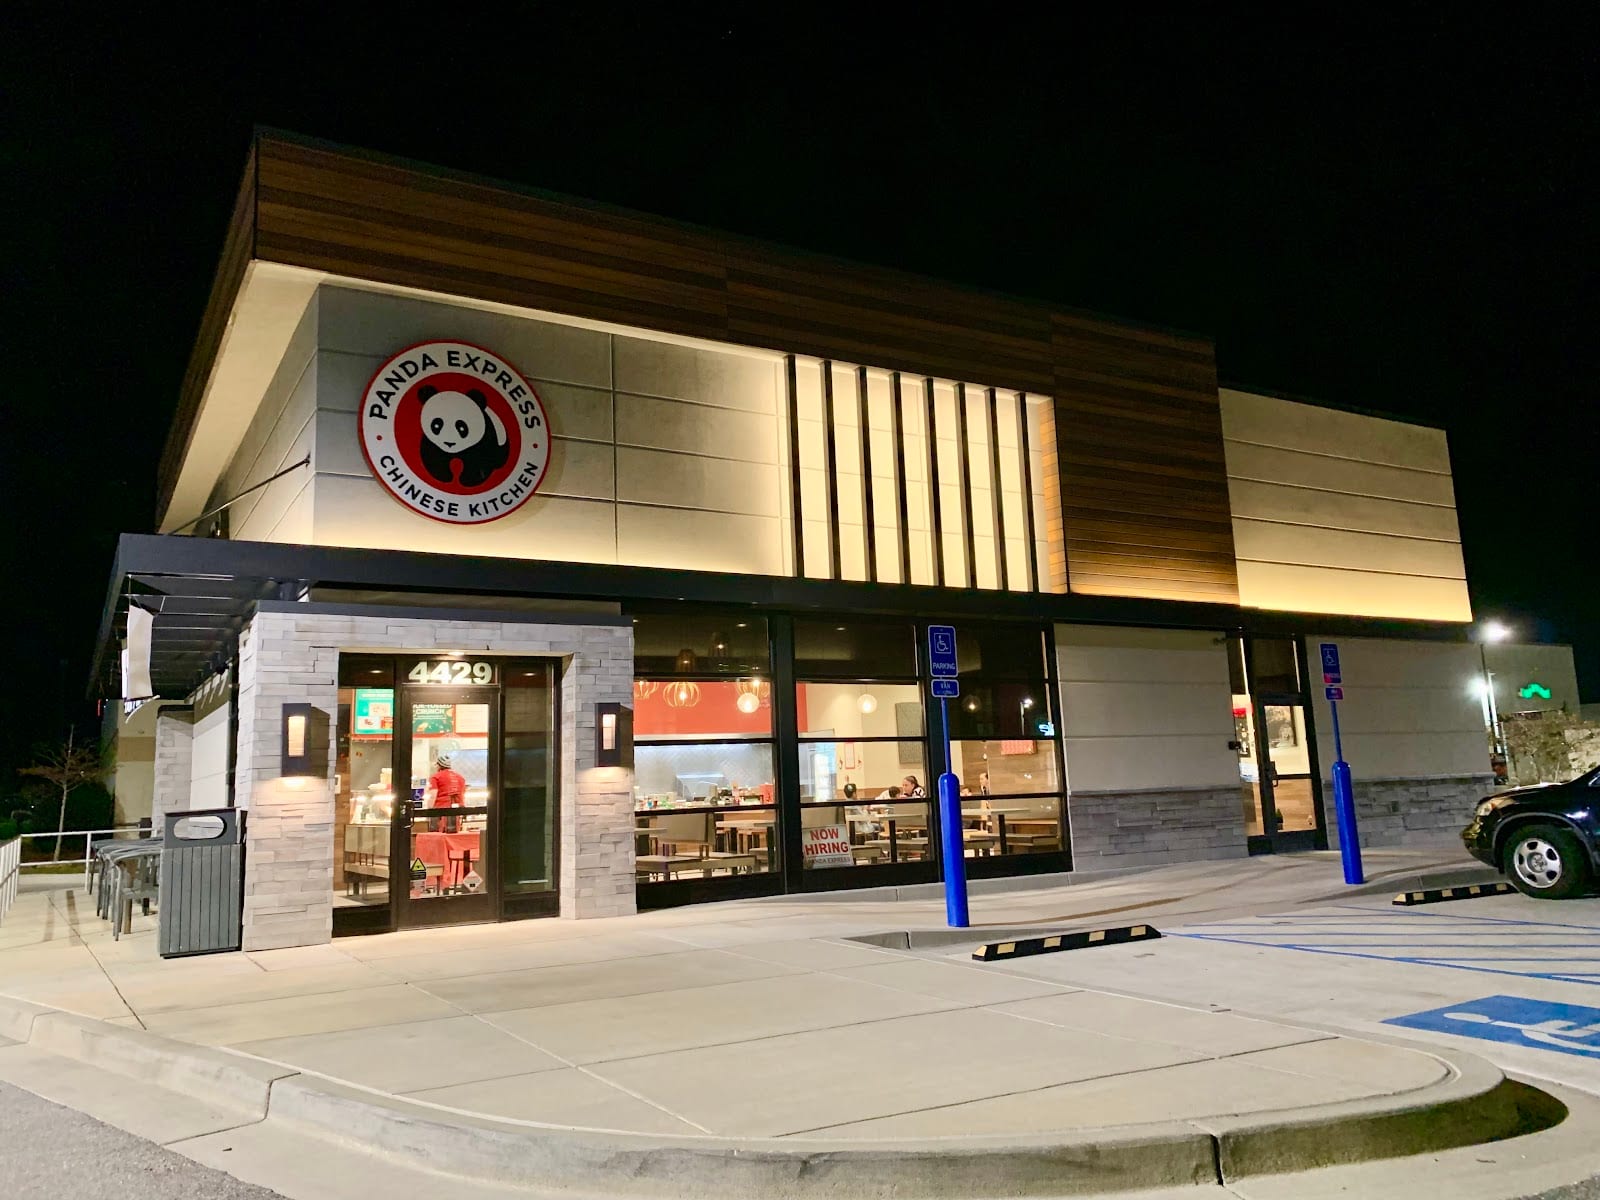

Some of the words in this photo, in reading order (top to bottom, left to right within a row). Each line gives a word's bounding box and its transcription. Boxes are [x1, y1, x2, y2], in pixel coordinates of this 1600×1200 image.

[369, 353, 439, 420] PANDA
[447, 350, 541, 429] EXPRESS
[380, 455, 459, 516] CHINESE
[469, 462, 539, 517] KITCHEN
[408, 661, 492, 685] 4429
[932, 662, 956, 670] PARKING
[809, 828, 839, 841] NOW
[805, 841, 849, 855] HIRING
